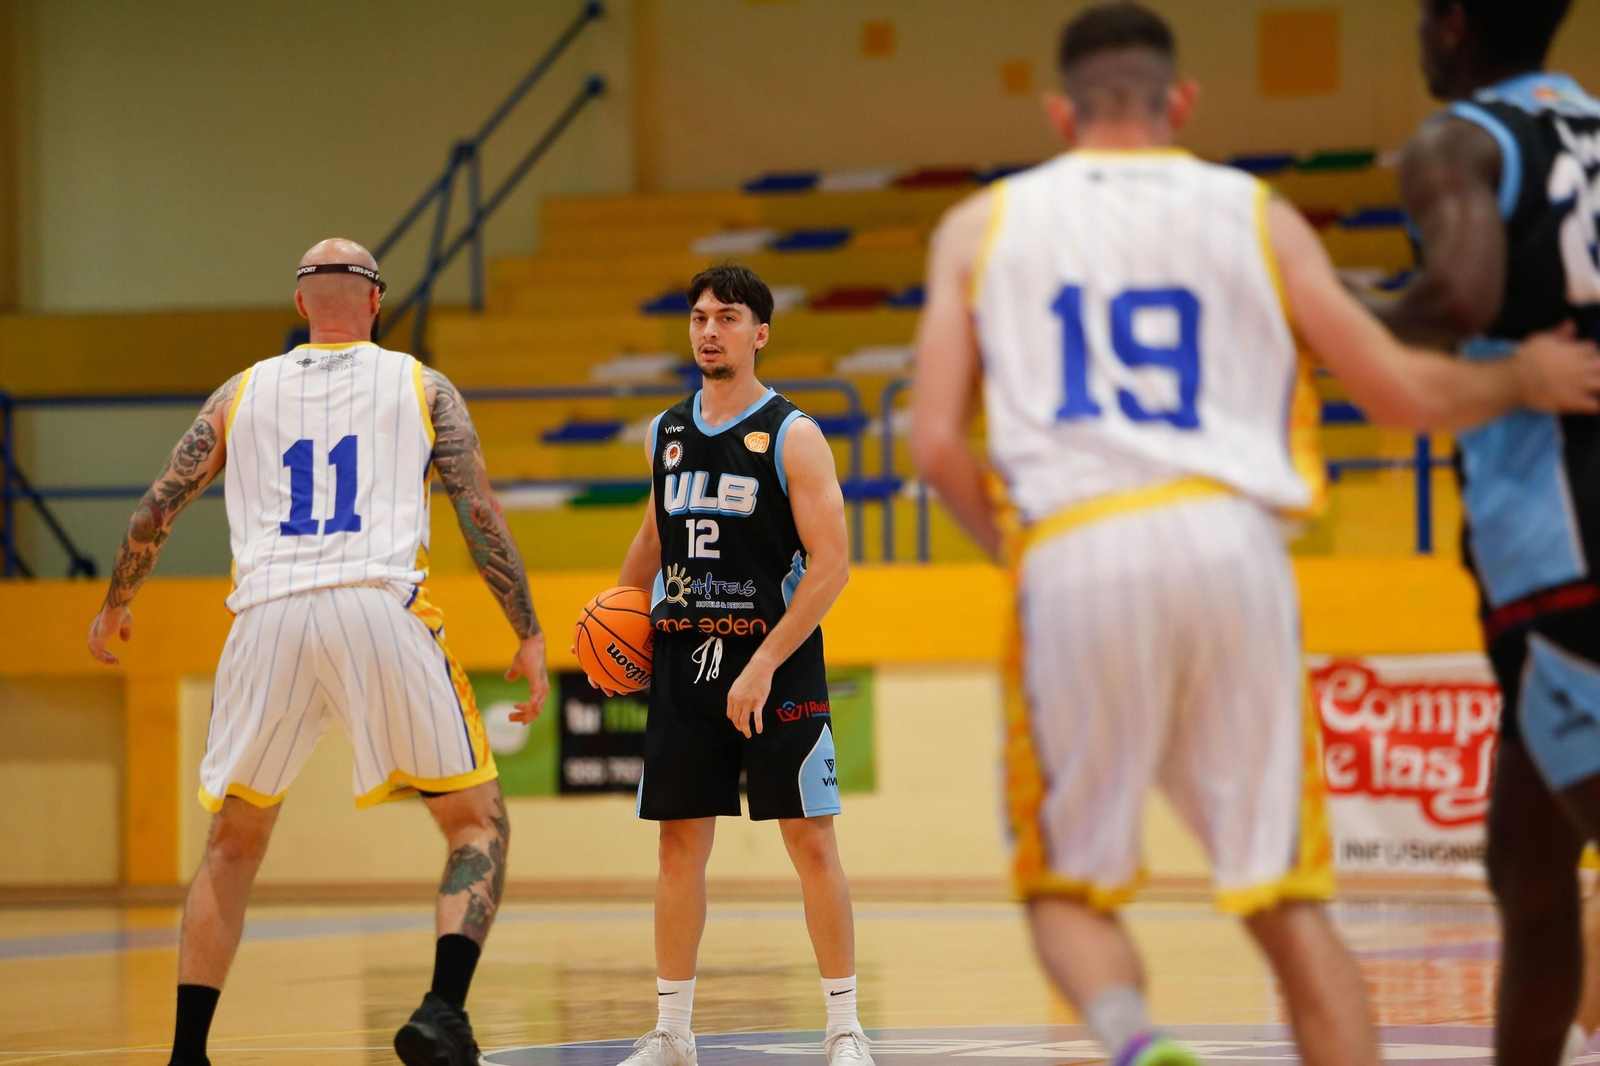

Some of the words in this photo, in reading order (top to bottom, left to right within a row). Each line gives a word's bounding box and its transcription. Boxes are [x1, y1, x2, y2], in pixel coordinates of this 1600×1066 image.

[1050, 283, 1202, 431] 19
[280, 434, 362, 536] 11
[664, 471, 760, 517] ULB
[685, 518, 721, 559] 12
[695, 600, 720, 609] HOTELS
[727, 601, 755, 609] RESORTS
[1320, 667, 1502, 747] Comp
[1370, 732, 1463, 790] las
